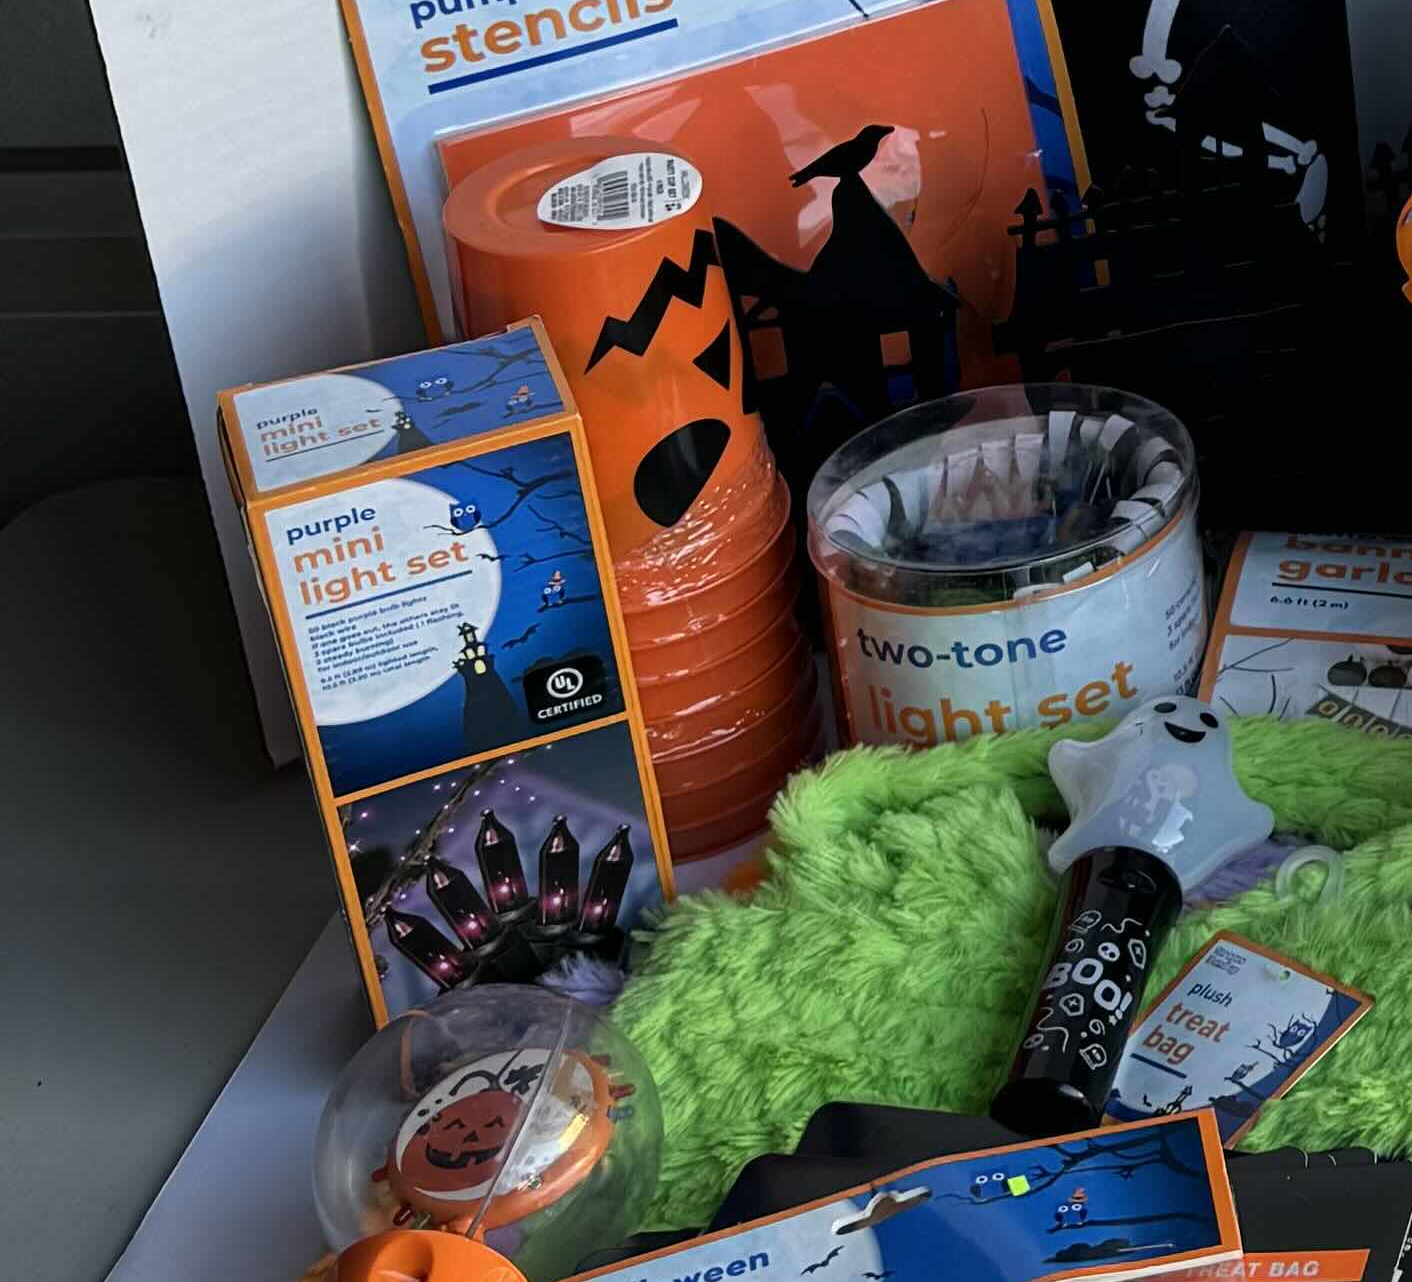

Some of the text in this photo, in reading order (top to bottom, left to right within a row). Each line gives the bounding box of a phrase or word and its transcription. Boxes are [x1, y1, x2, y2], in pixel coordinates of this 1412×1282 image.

[256, 408, 318, 430] purple
[260, 416, 322, 443] mini
[263, 418, 382, 457] light set
[286, 507, 376, 546] purple
[294, 525, 385, 574] mini
[299, 541, 469, 605] light set
[1270, 595, 1349, 610] 6.6 (2 m)
[856, 626, 1068, 671] two-tone
[554, 675, 576, 691] UL
[537, 693, 603, 719] CERTIFIED
[869, 660, 1139, 750] light set
[1187, 982, 1233, 1007] plush
[1165, 1001, 1231, 1043] treat
[1142, 1024, 1195, 1066] bag
[1269, 1261, 1320, 1277] BAG
